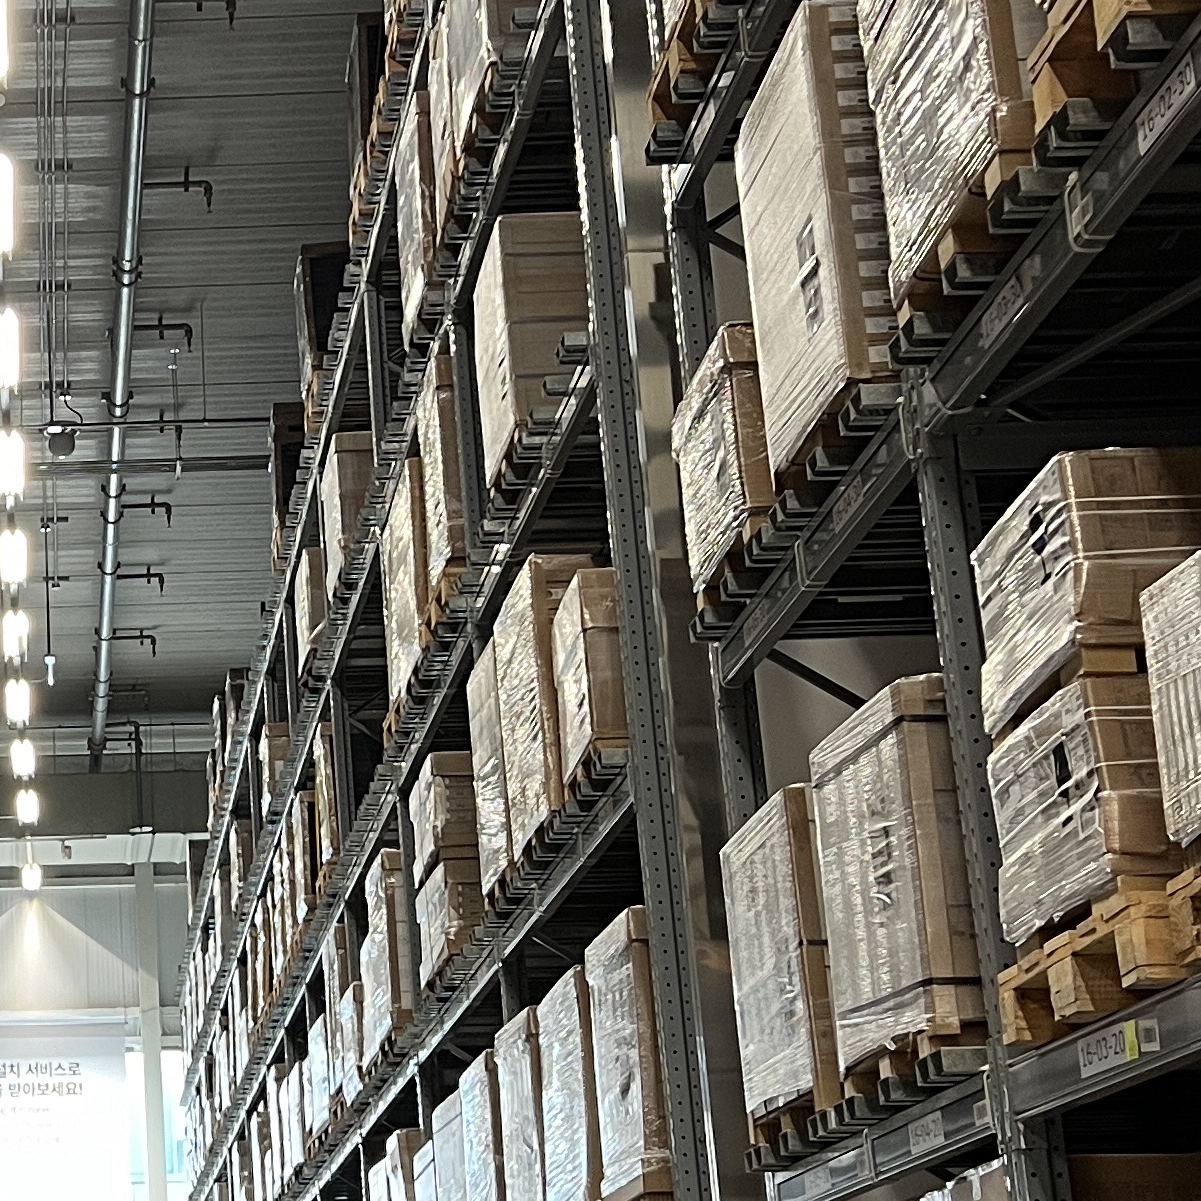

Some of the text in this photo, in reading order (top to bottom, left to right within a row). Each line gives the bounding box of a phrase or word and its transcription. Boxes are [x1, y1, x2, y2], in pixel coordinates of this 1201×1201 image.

[1139, 61, 1192, 141] 16-02-30
[1081, 1029, 1125, 1067] 16-03-20
[26, 1061, 81, 1078] 서비스로
[8, 1081, 83, 1098] 받아보세요!
